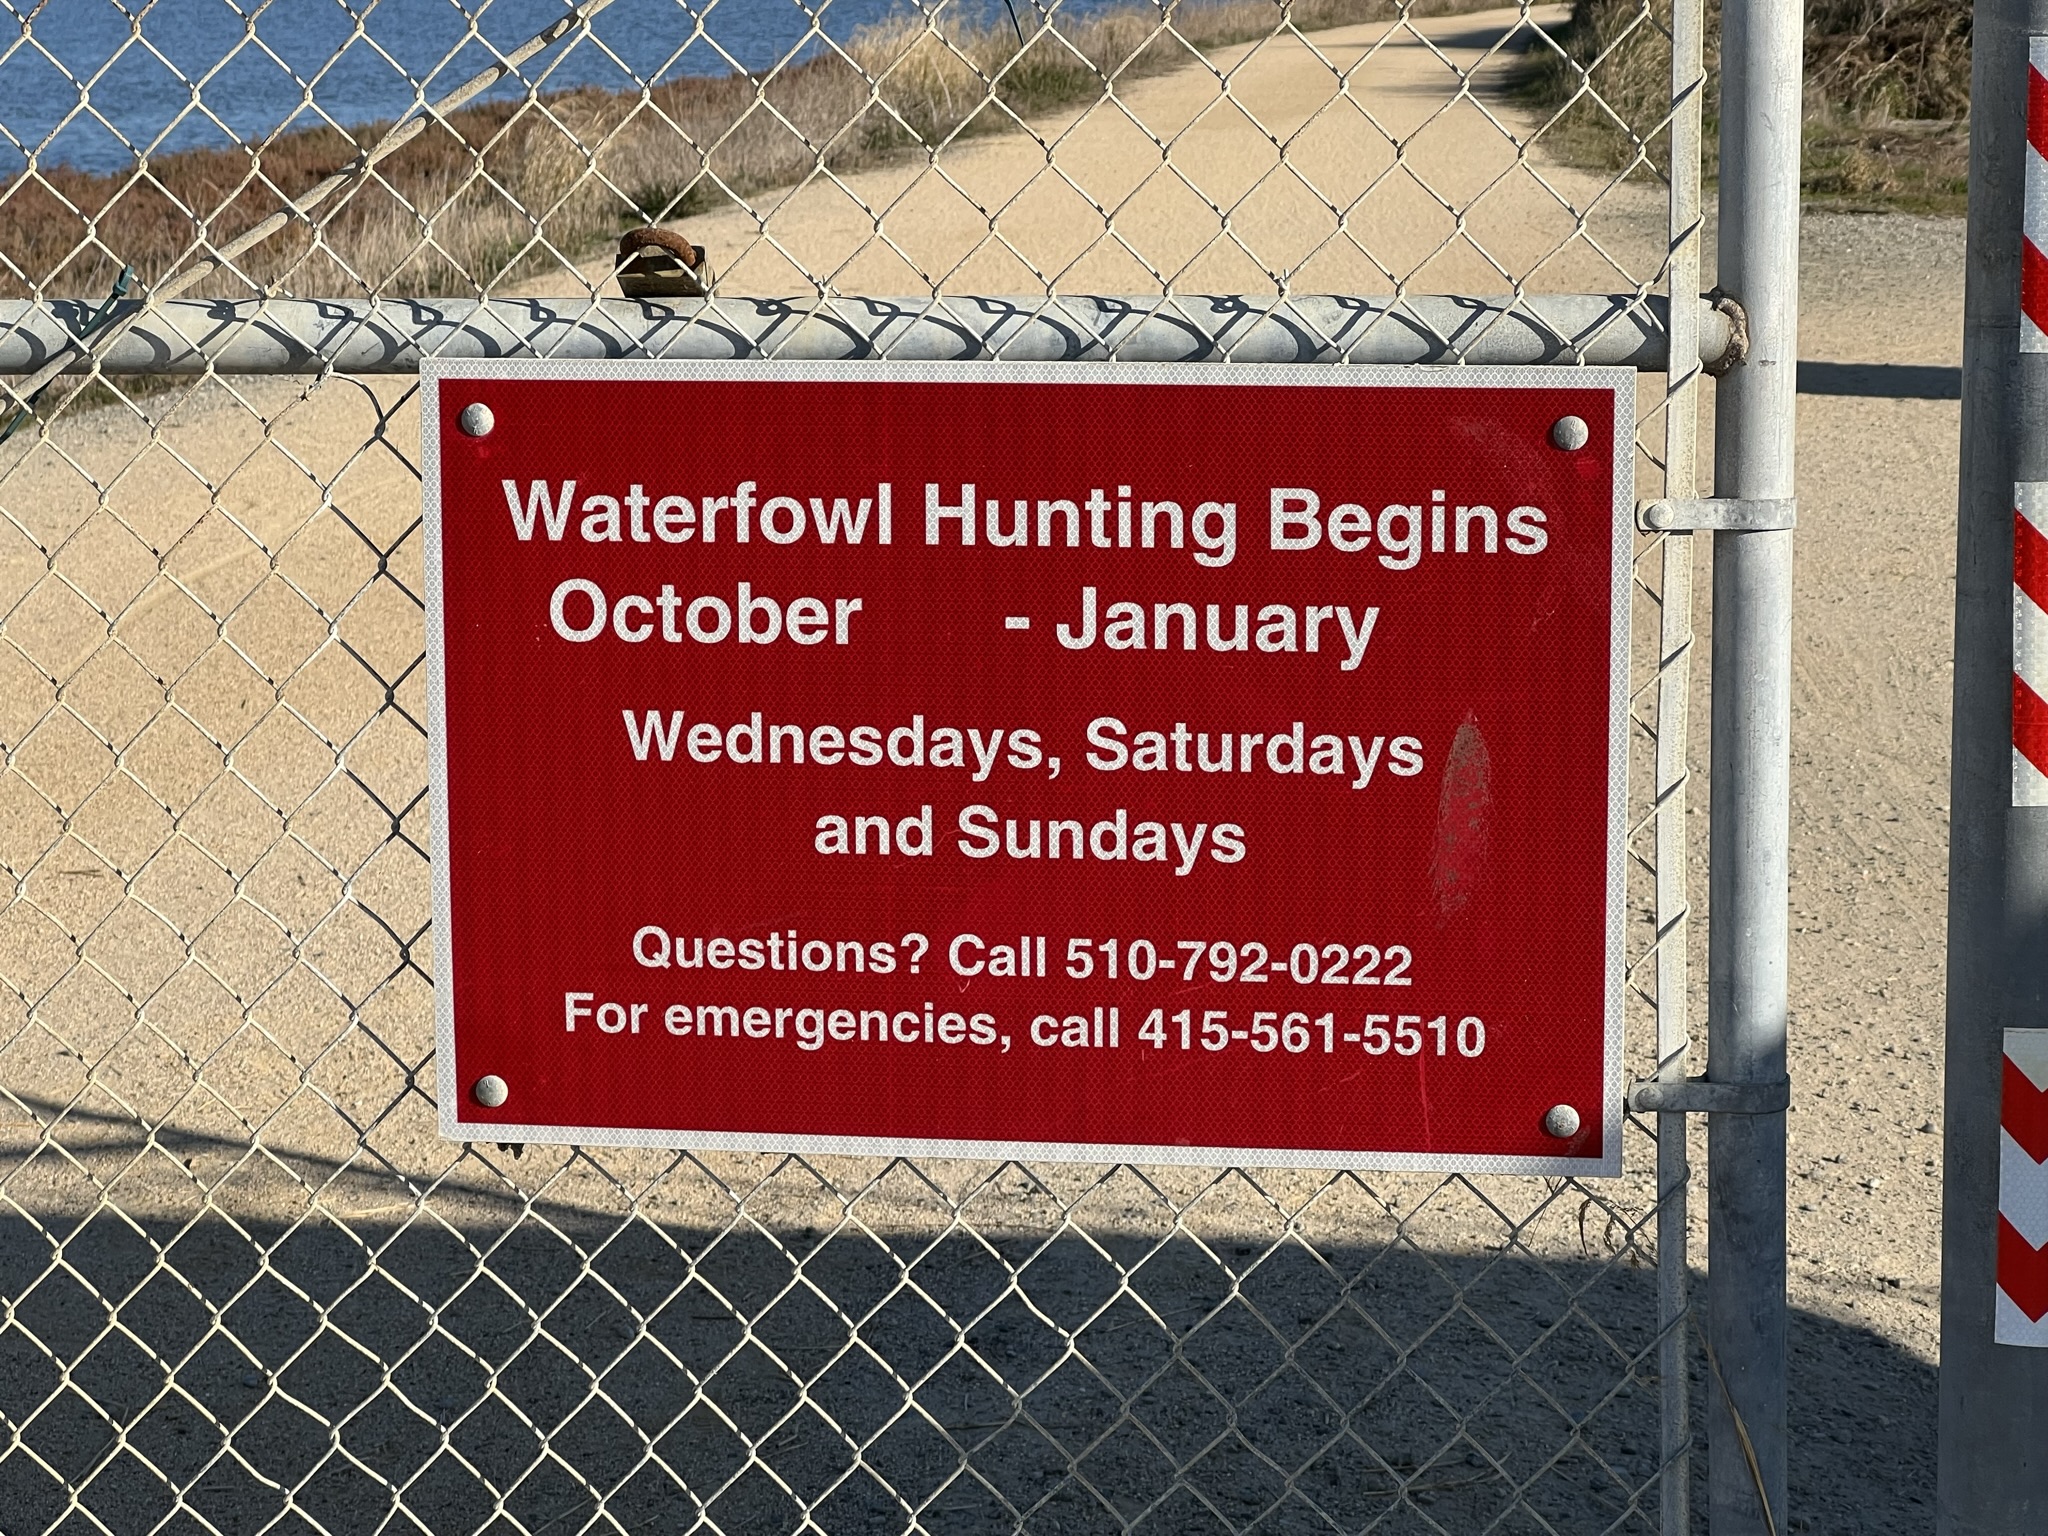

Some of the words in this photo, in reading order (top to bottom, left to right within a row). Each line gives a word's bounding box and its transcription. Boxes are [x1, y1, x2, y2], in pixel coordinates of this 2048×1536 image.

[502, 479, 892, 546] Waterfowl
[925, 482, 1237, 568] Hunting
[1270, 487, 1548, 571] Begins
[549, 578, 863, 645] October
[1004, 616, 1030, 630] -
[1056, 586, 1380, 671] January
[622, 709, 1061, 782] Wednesdays,
[1085, 716, 1424, 790] Saturdays
[814, 804, 933, 858] and
[957, 804, 1246, 877] Sundays
[632, 925, 929, 976] Questions?
[948, 933, 1047, 978] Call
[1065, 938, 1412, 987] 510-792-0222
[565, 991, 649, 1035] For
[664, 1001, 1012, 1054] emergencies,
[1030, 1006, 1119, 1049] call
[1138, 1008, 1486, 1058] 415-561-5510
